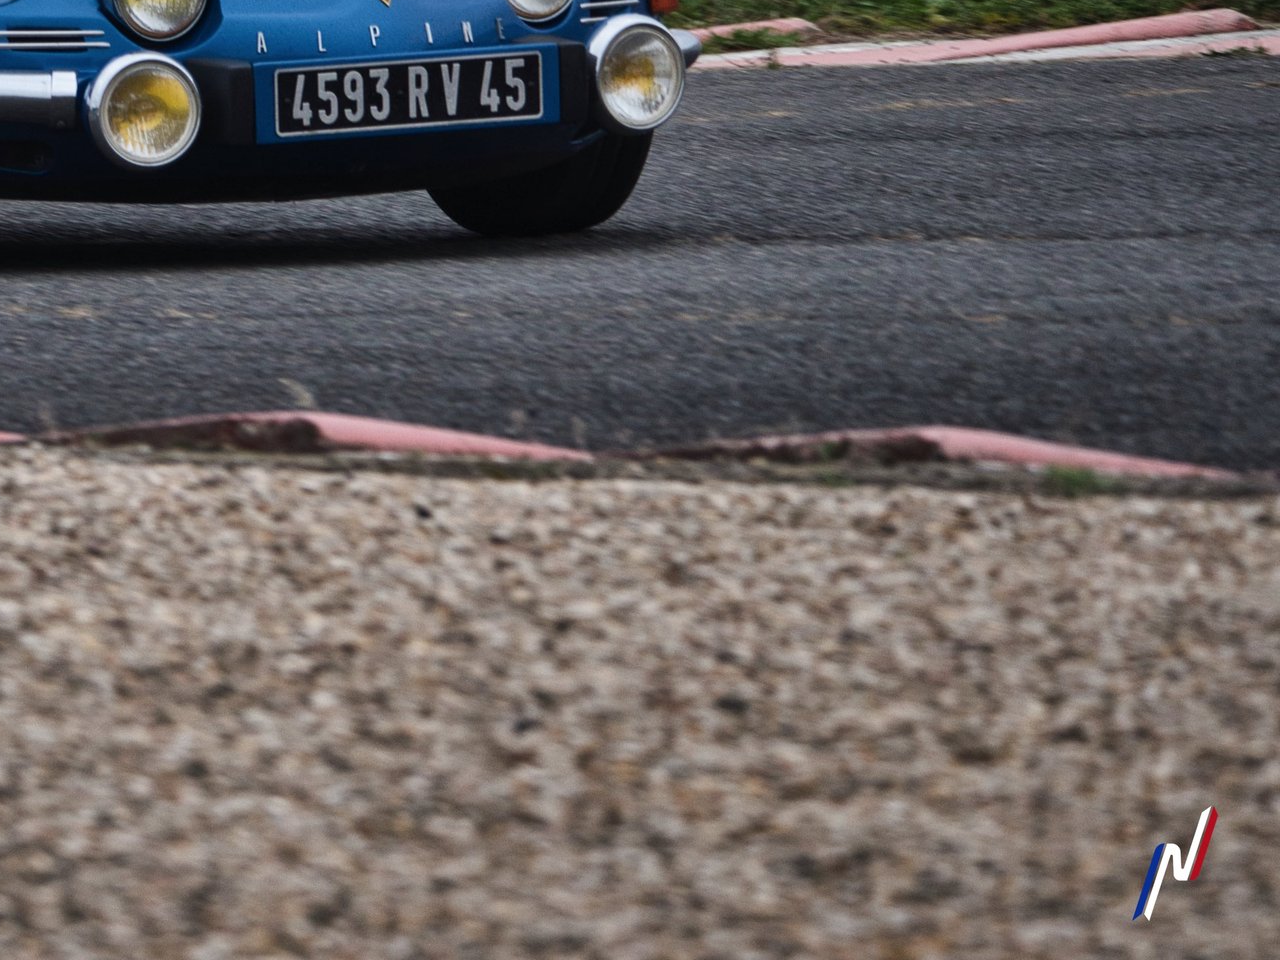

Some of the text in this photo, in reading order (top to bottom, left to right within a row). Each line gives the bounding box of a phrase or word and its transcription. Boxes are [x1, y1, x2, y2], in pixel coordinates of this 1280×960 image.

[256, 17, 506, 54] ALPINE
[291, 67, 391, 127] 4593
[479, 58, 527, 113] 45
